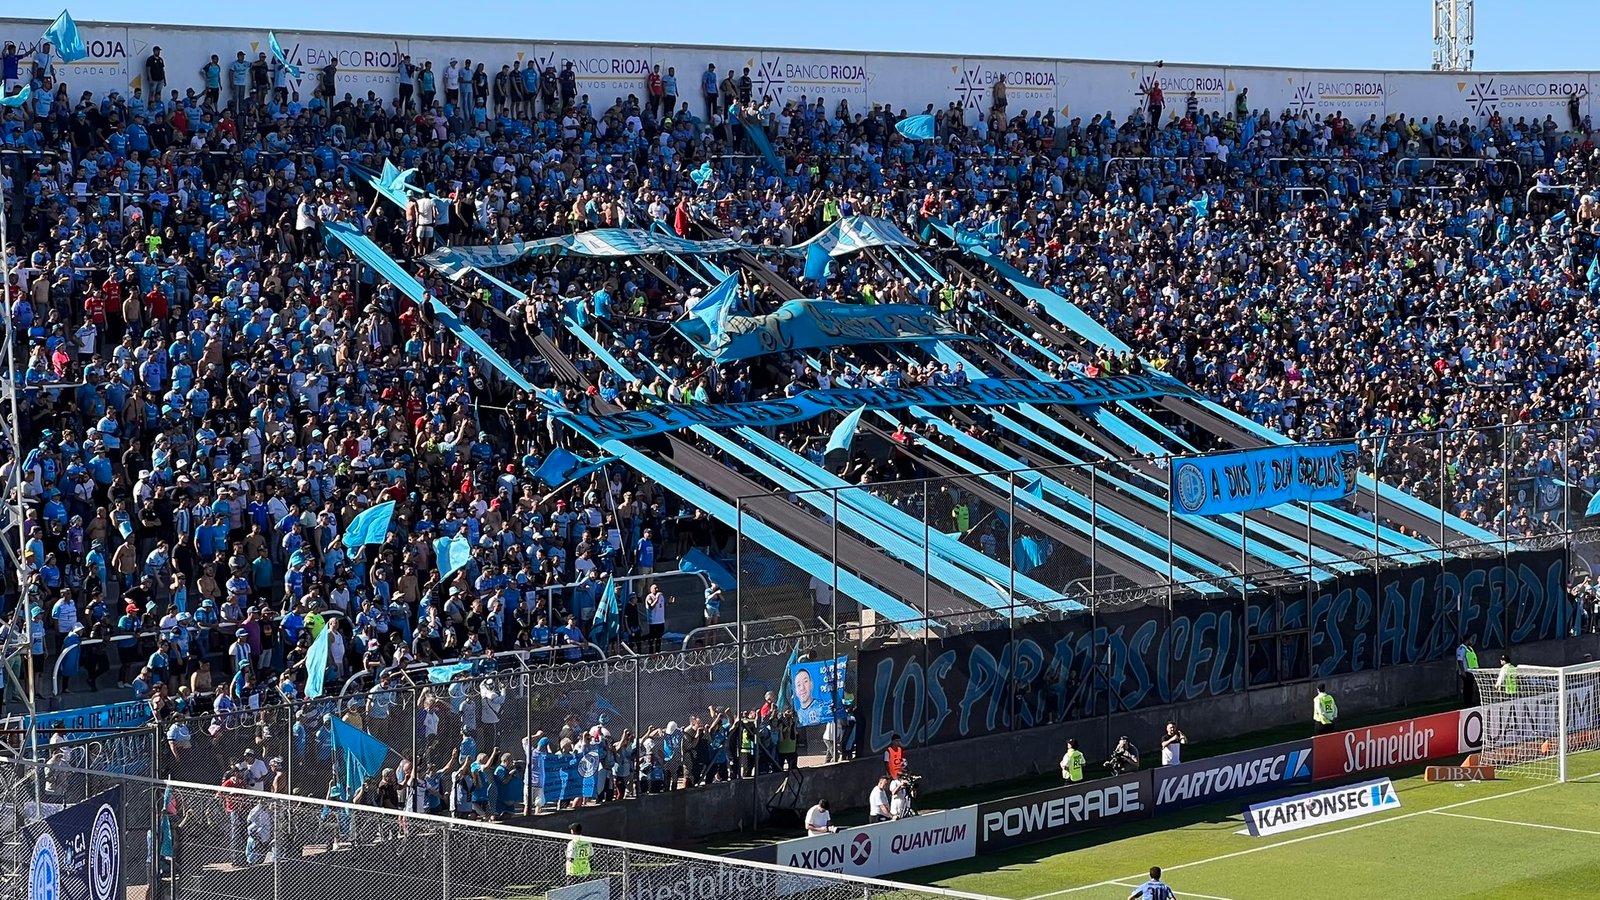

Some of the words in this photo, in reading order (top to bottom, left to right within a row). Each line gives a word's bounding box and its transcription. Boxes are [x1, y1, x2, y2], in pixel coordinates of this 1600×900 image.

[86, 41, 127, 58] iOJA
[785, 64, 829, 79] BANCO
[831, 66, 866, 80] RiOJA
[1025, 72, 1056, 86] RiOJA
[1160, 78, 1195, 91] BANCO
[1317, 82, 1353, 95] BANCO
[1499, 84, 1547, 96] BANCO
[870, 649, 958, 754] LOS
[1343, 720, 1434, 773] Schneider
[1156, 754, 1286, 806] KARTONSEC
[1435, 767, 1486, 780] LIBRA
[983, 781, 1140, 842] POWERADE
[1257, 789, 1369, 829] KARTONSEC
[890, 824, 967, 855] QUANTIUM
[789, 844, 845, 869] AXION
